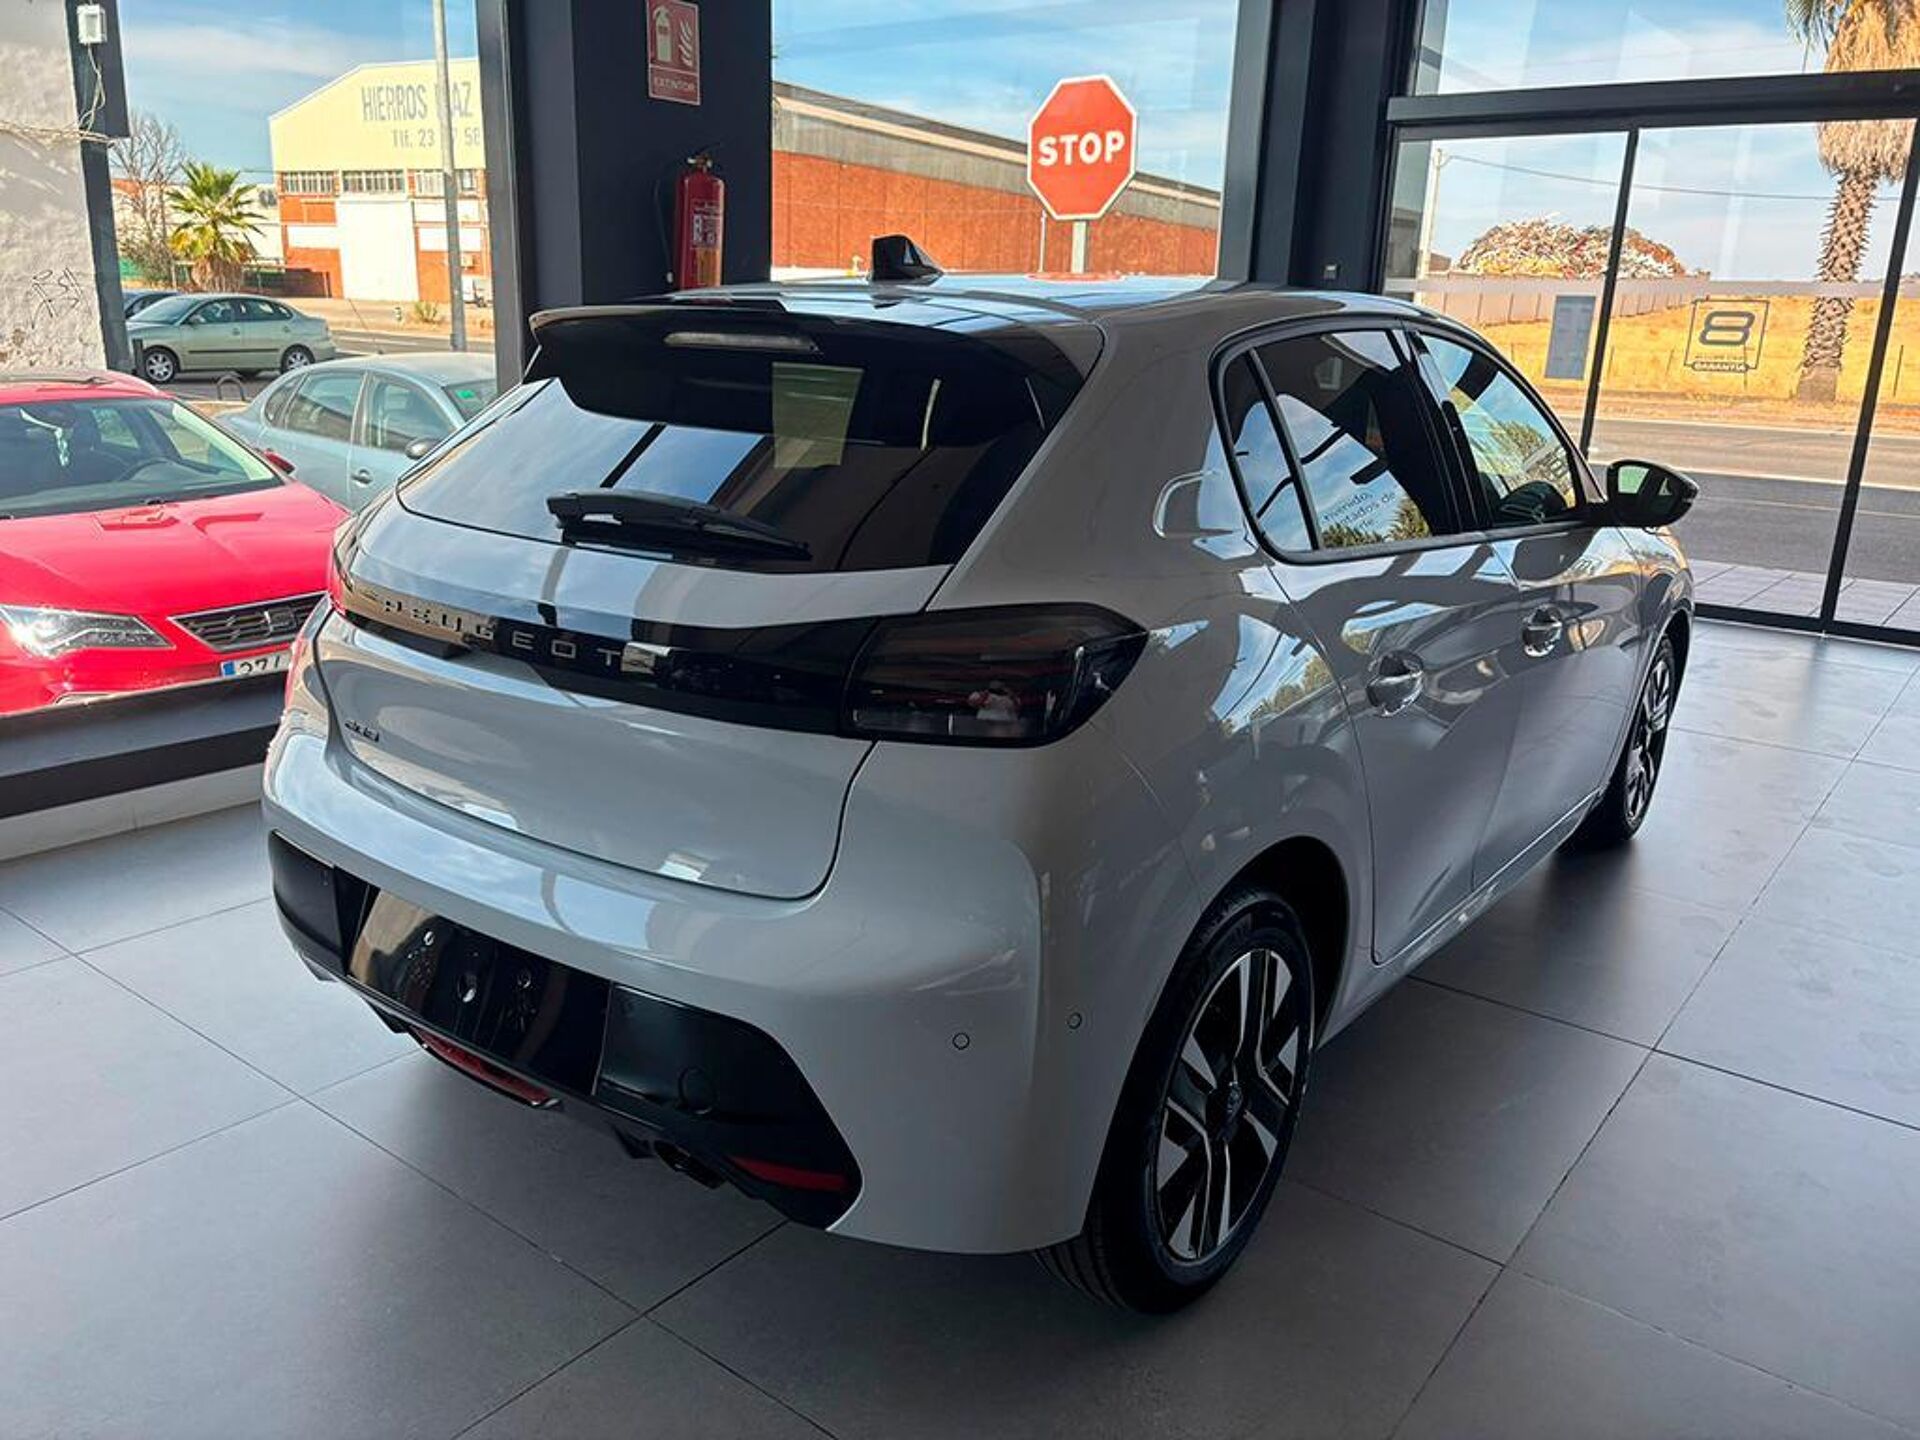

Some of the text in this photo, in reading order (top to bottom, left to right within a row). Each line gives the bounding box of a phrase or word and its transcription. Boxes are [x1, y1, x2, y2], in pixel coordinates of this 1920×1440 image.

[361, 84, 428, 121] HIERROS
[417, 128, 436, 148] 23
[1038, 130, 1126, 167] STOP
[1699, 311, 1755, 344] 8
[385, 599, 622, 667] PEUGEOT
